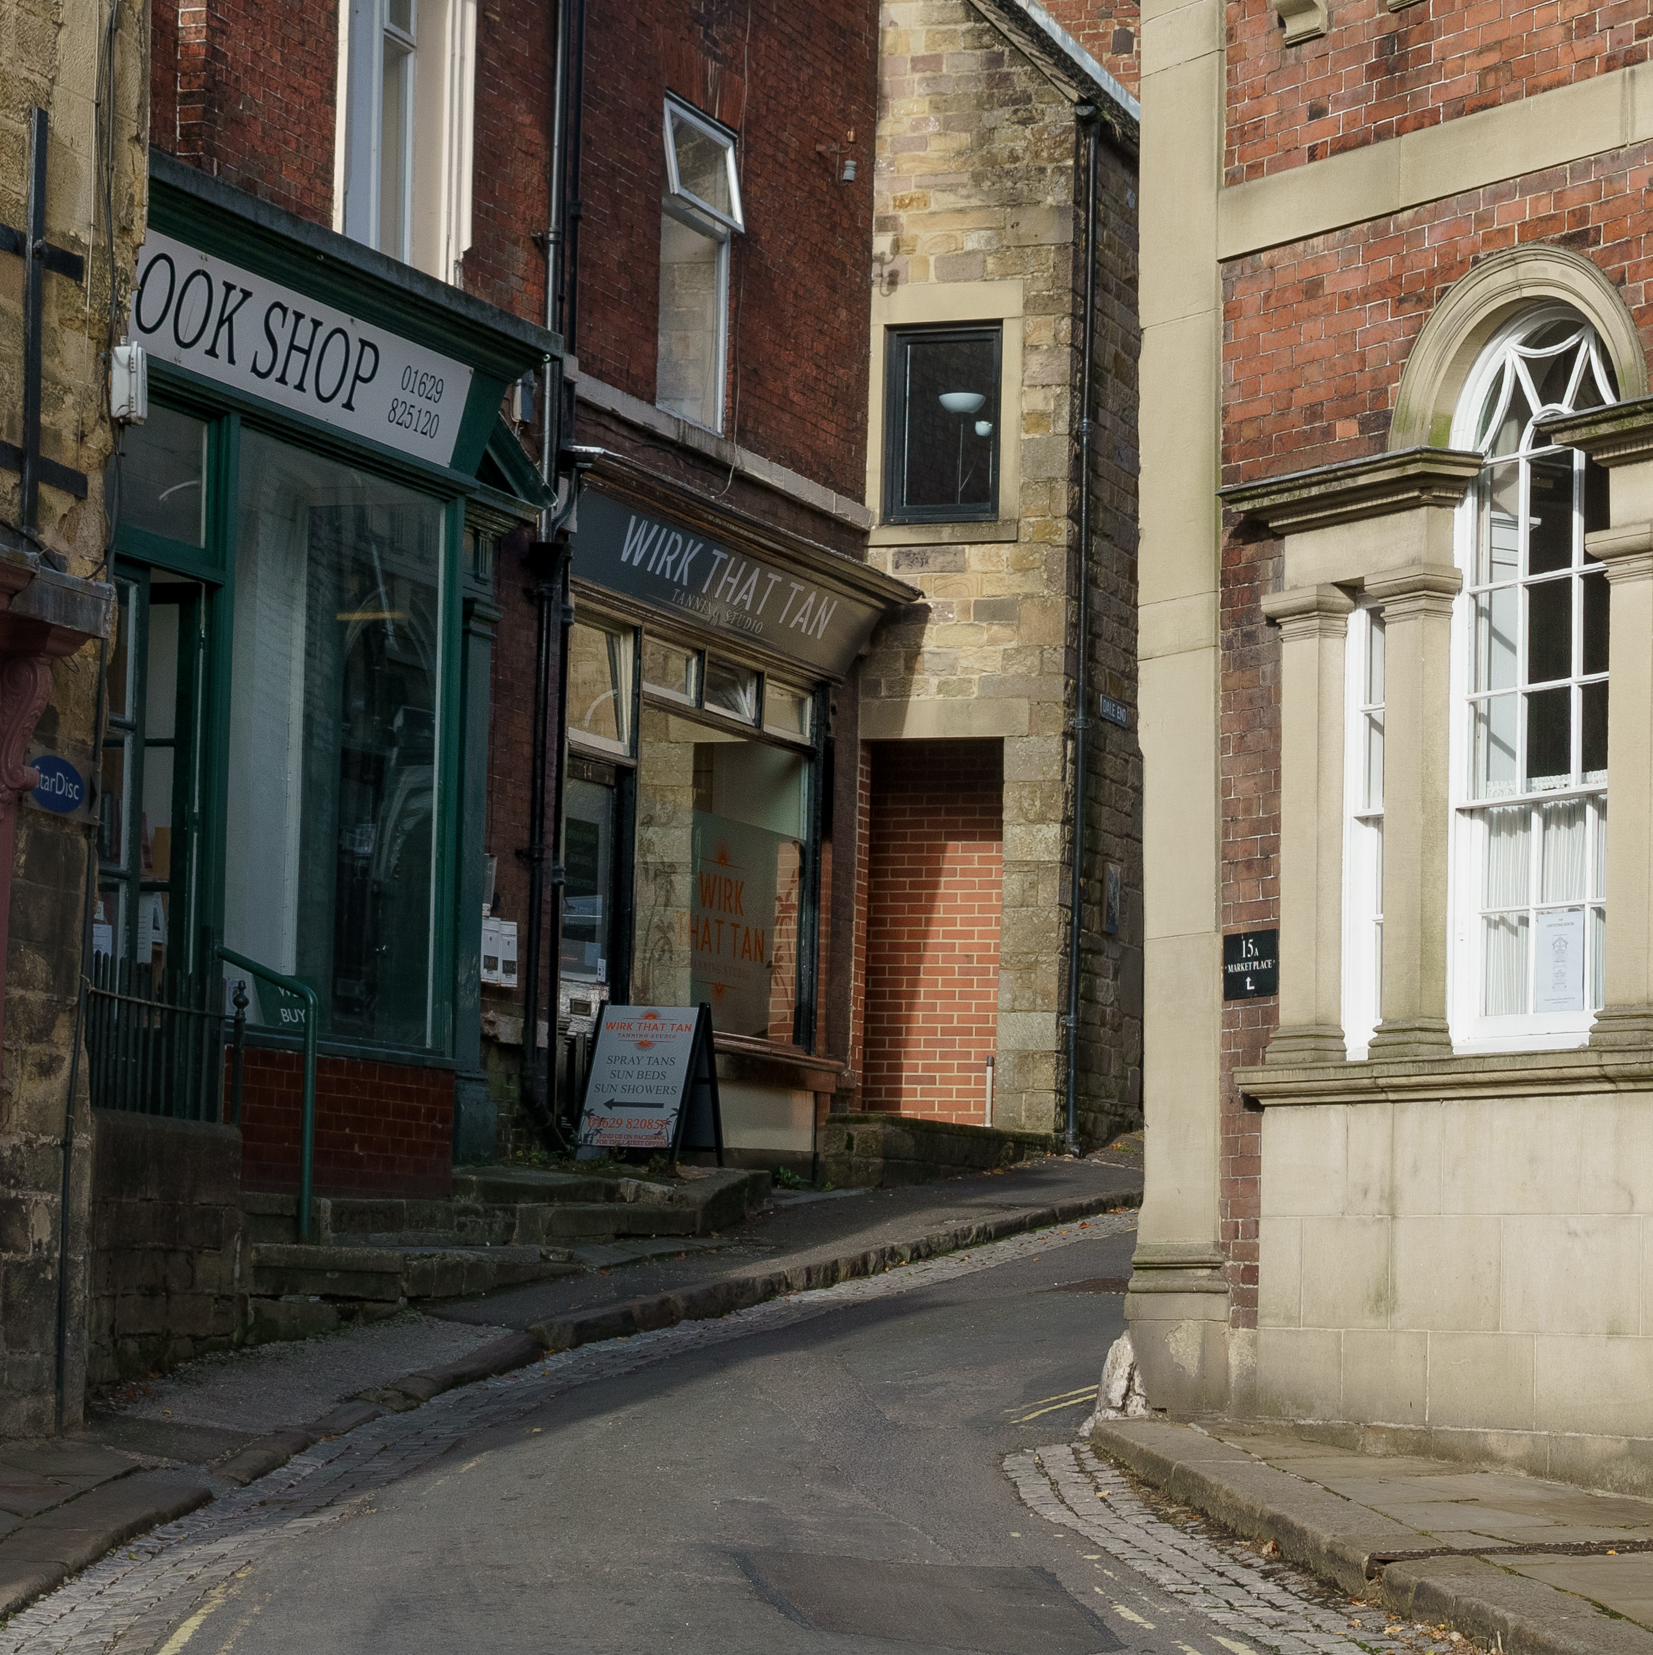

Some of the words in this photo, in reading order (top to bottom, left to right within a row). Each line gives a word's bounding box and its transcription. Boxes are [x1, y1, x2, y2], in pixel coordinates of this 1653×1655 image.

[135, 253, 253, 366] OOK
[250, 301, 380, 412] SHOP
[401, 365, 444, 403] 01629
[388, 398, 440, 439] 825120
[620, 514, 704, 586] WIRK
[701, 548, 783, 615] THAT
[778, 581, 839, 640] TAN
[672, 588, 722, 618] TANNING
[723, 609, 764, 634] STUDIO
[699, 871, 744, 916] WIRK
[676, 910, 725, 955] THAT
[730, 922, 765, 964] TAN
[1242, 939, 1259, 958] 15A
[1227, 962, 1253, 974] MARKET
[1253, 959, 1273, 970] PLACE
[280, 1008, 306, 1023] BUY
[605, 1021, 634, 1031] WIRK
[637, 1022, 667, 1032] THAT
[670, 1023, 693, 1033] TAN
[607, 1055, 644, 1066] SPRAY
[646, 1056, 676, 1066] TANS
[610, 1069, 634, 1080] SUN
[637, 1070, 667, 1081] BEDS
[594, 1083, 618, 1094] SUN
[620, 1084, 678, 1095] SHOWERS
[588, 1116, 623, 1129] 01629
